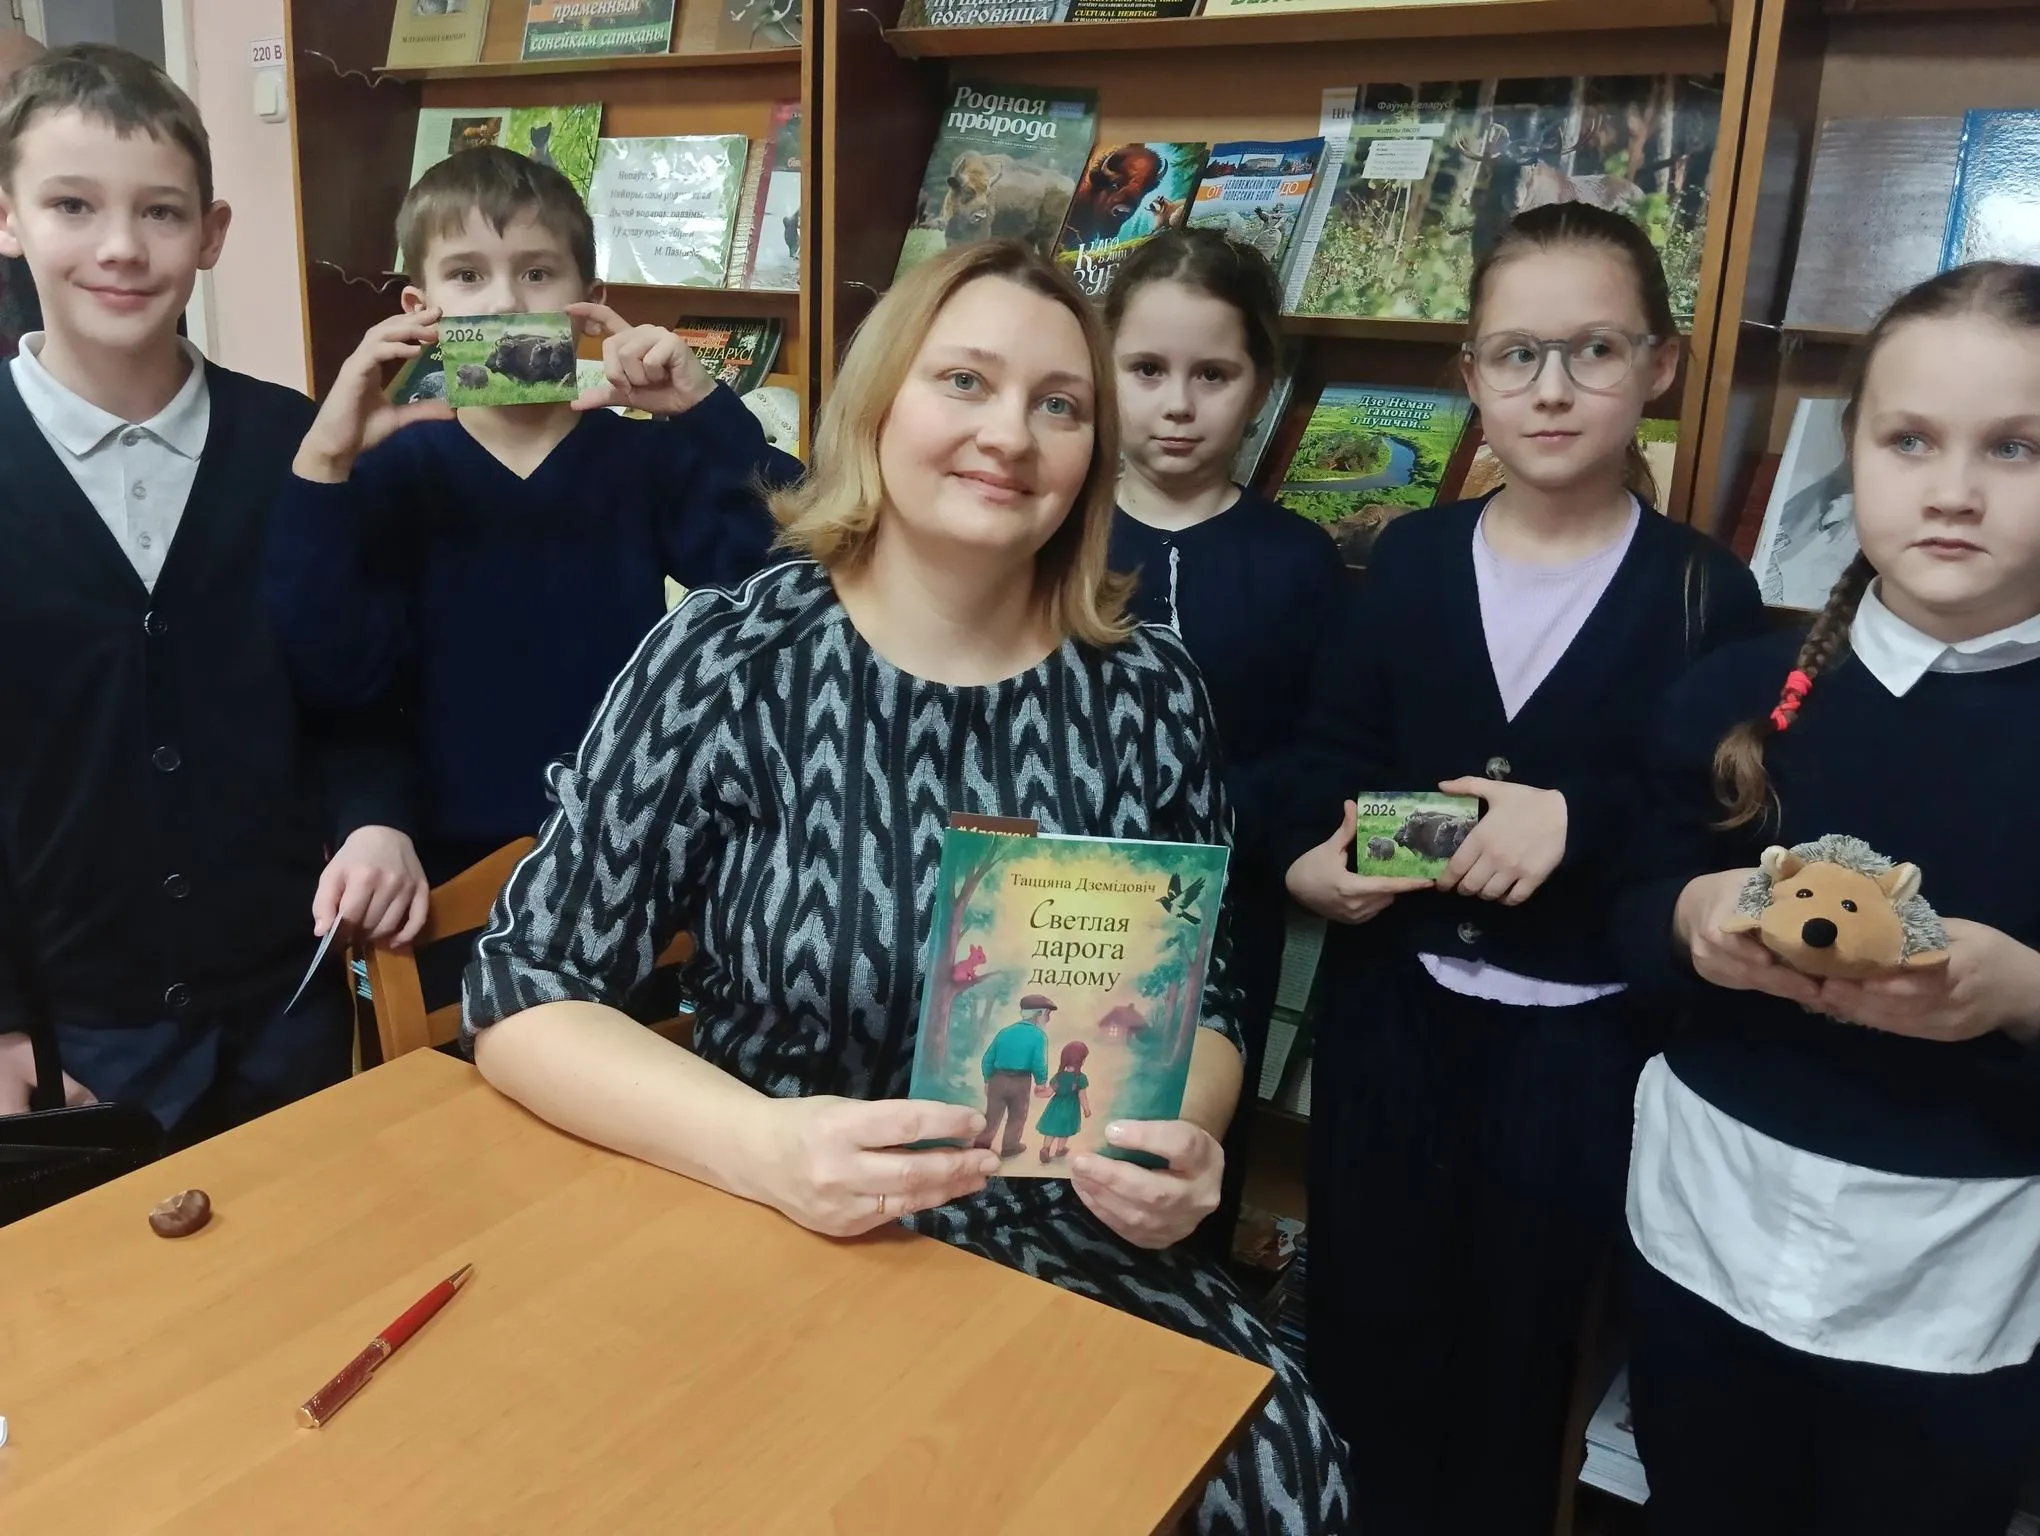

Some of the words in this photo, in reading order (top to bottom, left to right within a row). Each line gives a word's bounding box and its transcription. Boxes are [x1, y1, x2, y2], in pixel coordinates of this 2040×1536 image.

[931, 7, 1048, 25] СОКРОВИЩА
[530, 32, 597, 51] сонейкам
[600, 28, 664, 46] сатканы
[253, 46, 271, 62] 220
[274, 45, 282, 59] В
[953, 86, 1046, 115] Родная
[1377, 101, 1407, 112] Фауна
[947, 112, 1057, 142] прырода
[1206, 184, 1223, 198] ОТ
[1280, 182, 1299, 196] ДО
[1074, 263, 1120, 296] ЗУБ
[446, 329, 484, 342] 2026
[695, 346, 755, 361] БЕЛАРУСІ
[1358, 396, 1384, 407] Дзе
[1387, 397, 1434, 411] Нёман
[1351, 416, 1358, 424] з
[1362, 417, 1430, 429] пушчай...
[1366, 408, 1430, 420] гамоніць
[1363, 804, 1397, 817] 2026
[1011, 873, 1072, 889] Таццяна
[1075, 877, 1156, 893] Дземідовіч
[1030, 899, 1130, 933] Светлая
[1031, 939, 1125, 964] дарога
[1027, 968, 1121, 992] дадому
